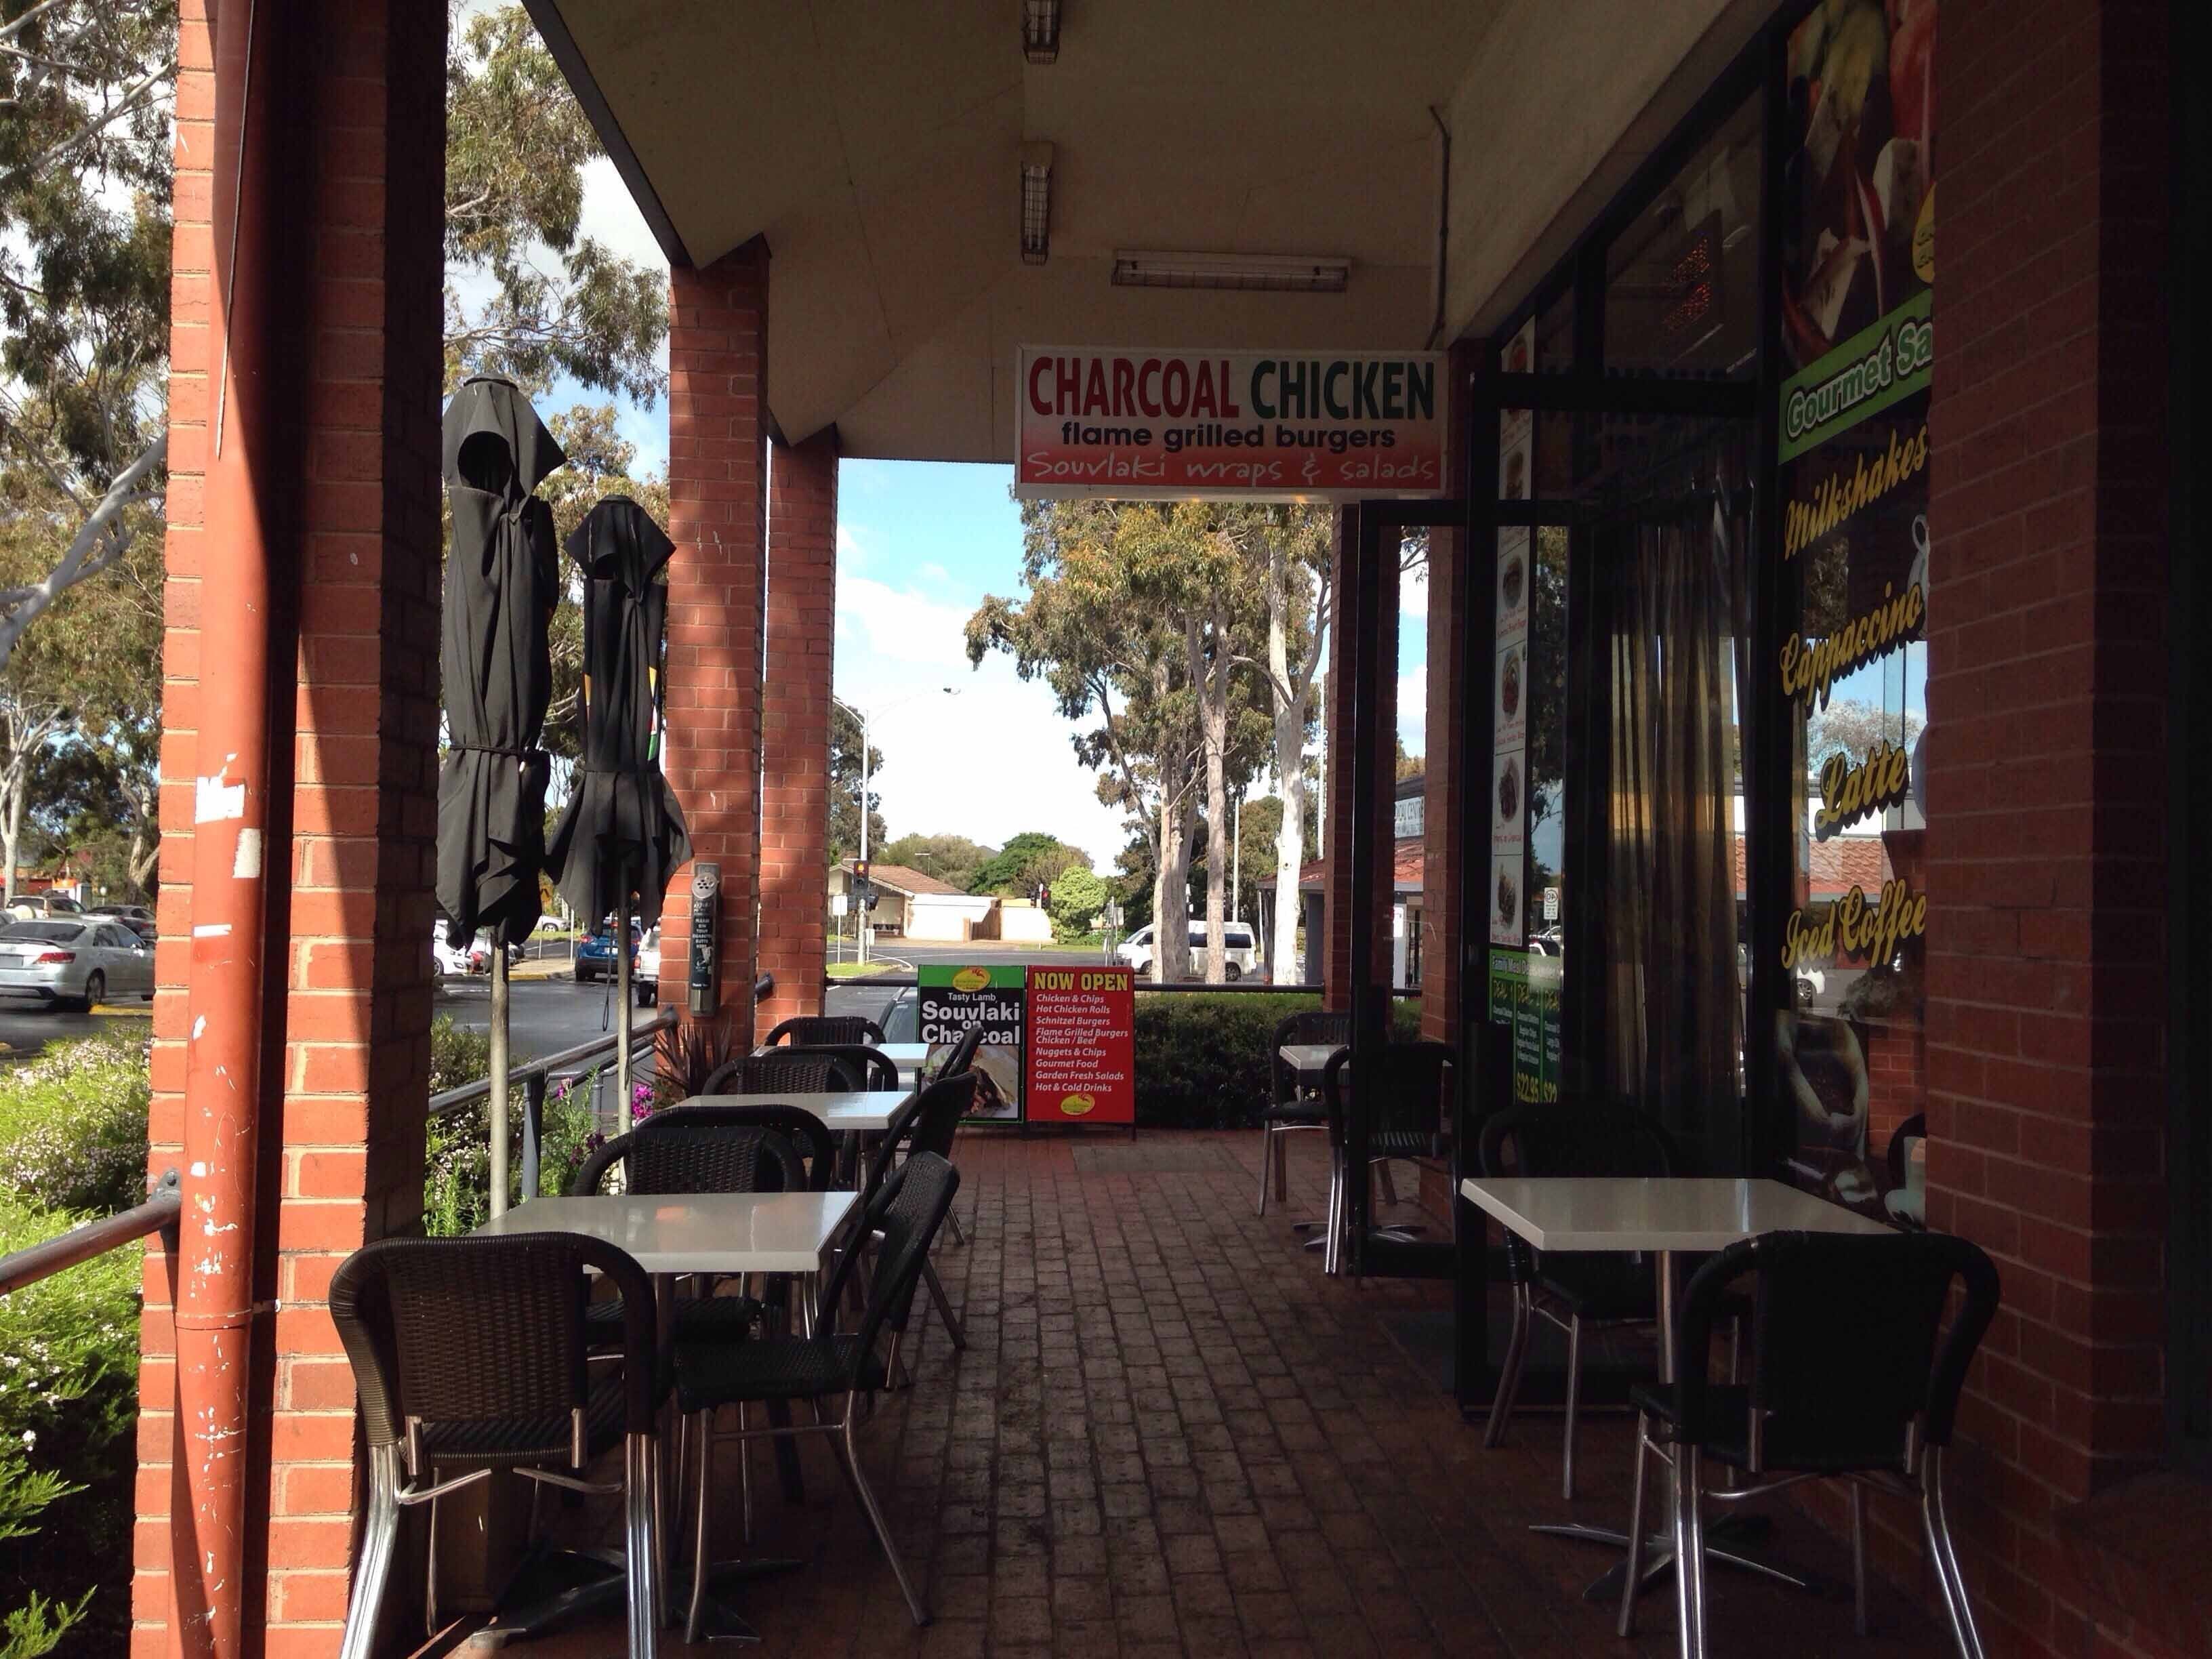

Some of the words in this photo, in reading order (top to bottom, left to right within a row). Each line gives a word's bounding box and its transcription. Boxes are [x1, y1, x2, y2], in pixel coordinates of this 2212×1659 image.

[1029, 356, 1240, 419] CHARCOAL
[1250, 361, 1435, 420] CHICKEN
[1787, 332, 1892, 438] Gourmet
[1061, 422, 1153, 446] flame
[1163, 424, 1265, 452] grilled
[1275, 424, 1396, 453] burgers
[1027, 452, 1166, 478] Souvlaki
[1186, 456, 1283, 487] wraps
[1300, 453, 1321, 485] &
[1339, 455, 1435, 481] salads
[1784, 424, 1928, 561] Milkshakes
[1815, 740, 1908, 830] Latte
[1781, 900, 1837, 970] Iced
[1839, 878, 1927, 968] Coffee
[1034, 972, 1074, 989] NOW
[1081, 973, 1128, 991] OPEN
[948, 992, 970, 1003] Tasty
[1036, 994, 1070, 1002] Chicken
[1072, 994, 1079, 1002] &
[1080, 994, 1105, 1004] Chips
[922, 1000, 1020, 1021] Souvlaki
[1036, 1004, 1052, 1012] Hot
[1054, 1004, 1088, 1013] Chicken
[1089, 1005, 1111, 1014] Rolls
[1036, 1016, 1076, 1025] Schnitzel
[1076, 1017, 1111, 1027] Burgers
[922, 1023, 1020, 1044] Chaoal
[1036, 1027, 1063, 1036] Flame
[1064, 1028, 1094, 1036] Grilled
[1095, 1029, 1128, 1039] Burgers
[1036, 1035, 1070, 1044] Chicken
[1077, 1036, 1097, 1044] Beef
[1036, 1047, 1072, 1057] Nuggets
[1073, 1048, 1080, 1056] &
[1082, 1048, 1107, 1057] Chips
[1036, 1059, 1075, 1067] Gourmet
[1076, 1059, 1099, 1067] Food
[1036, 1071, 1068, 1079] Garden
[1069, 1071, 1093, 1080] Fresh
[1094, 1071, 1124, 1080] Salads
[1036, 1083, 1052, 1091] Hot
[1053, 1083, 1060, 1091] &
[1062, 1083, 1083, 1091] Cold
[1084, 1083, 1112, 1092] Drinks
